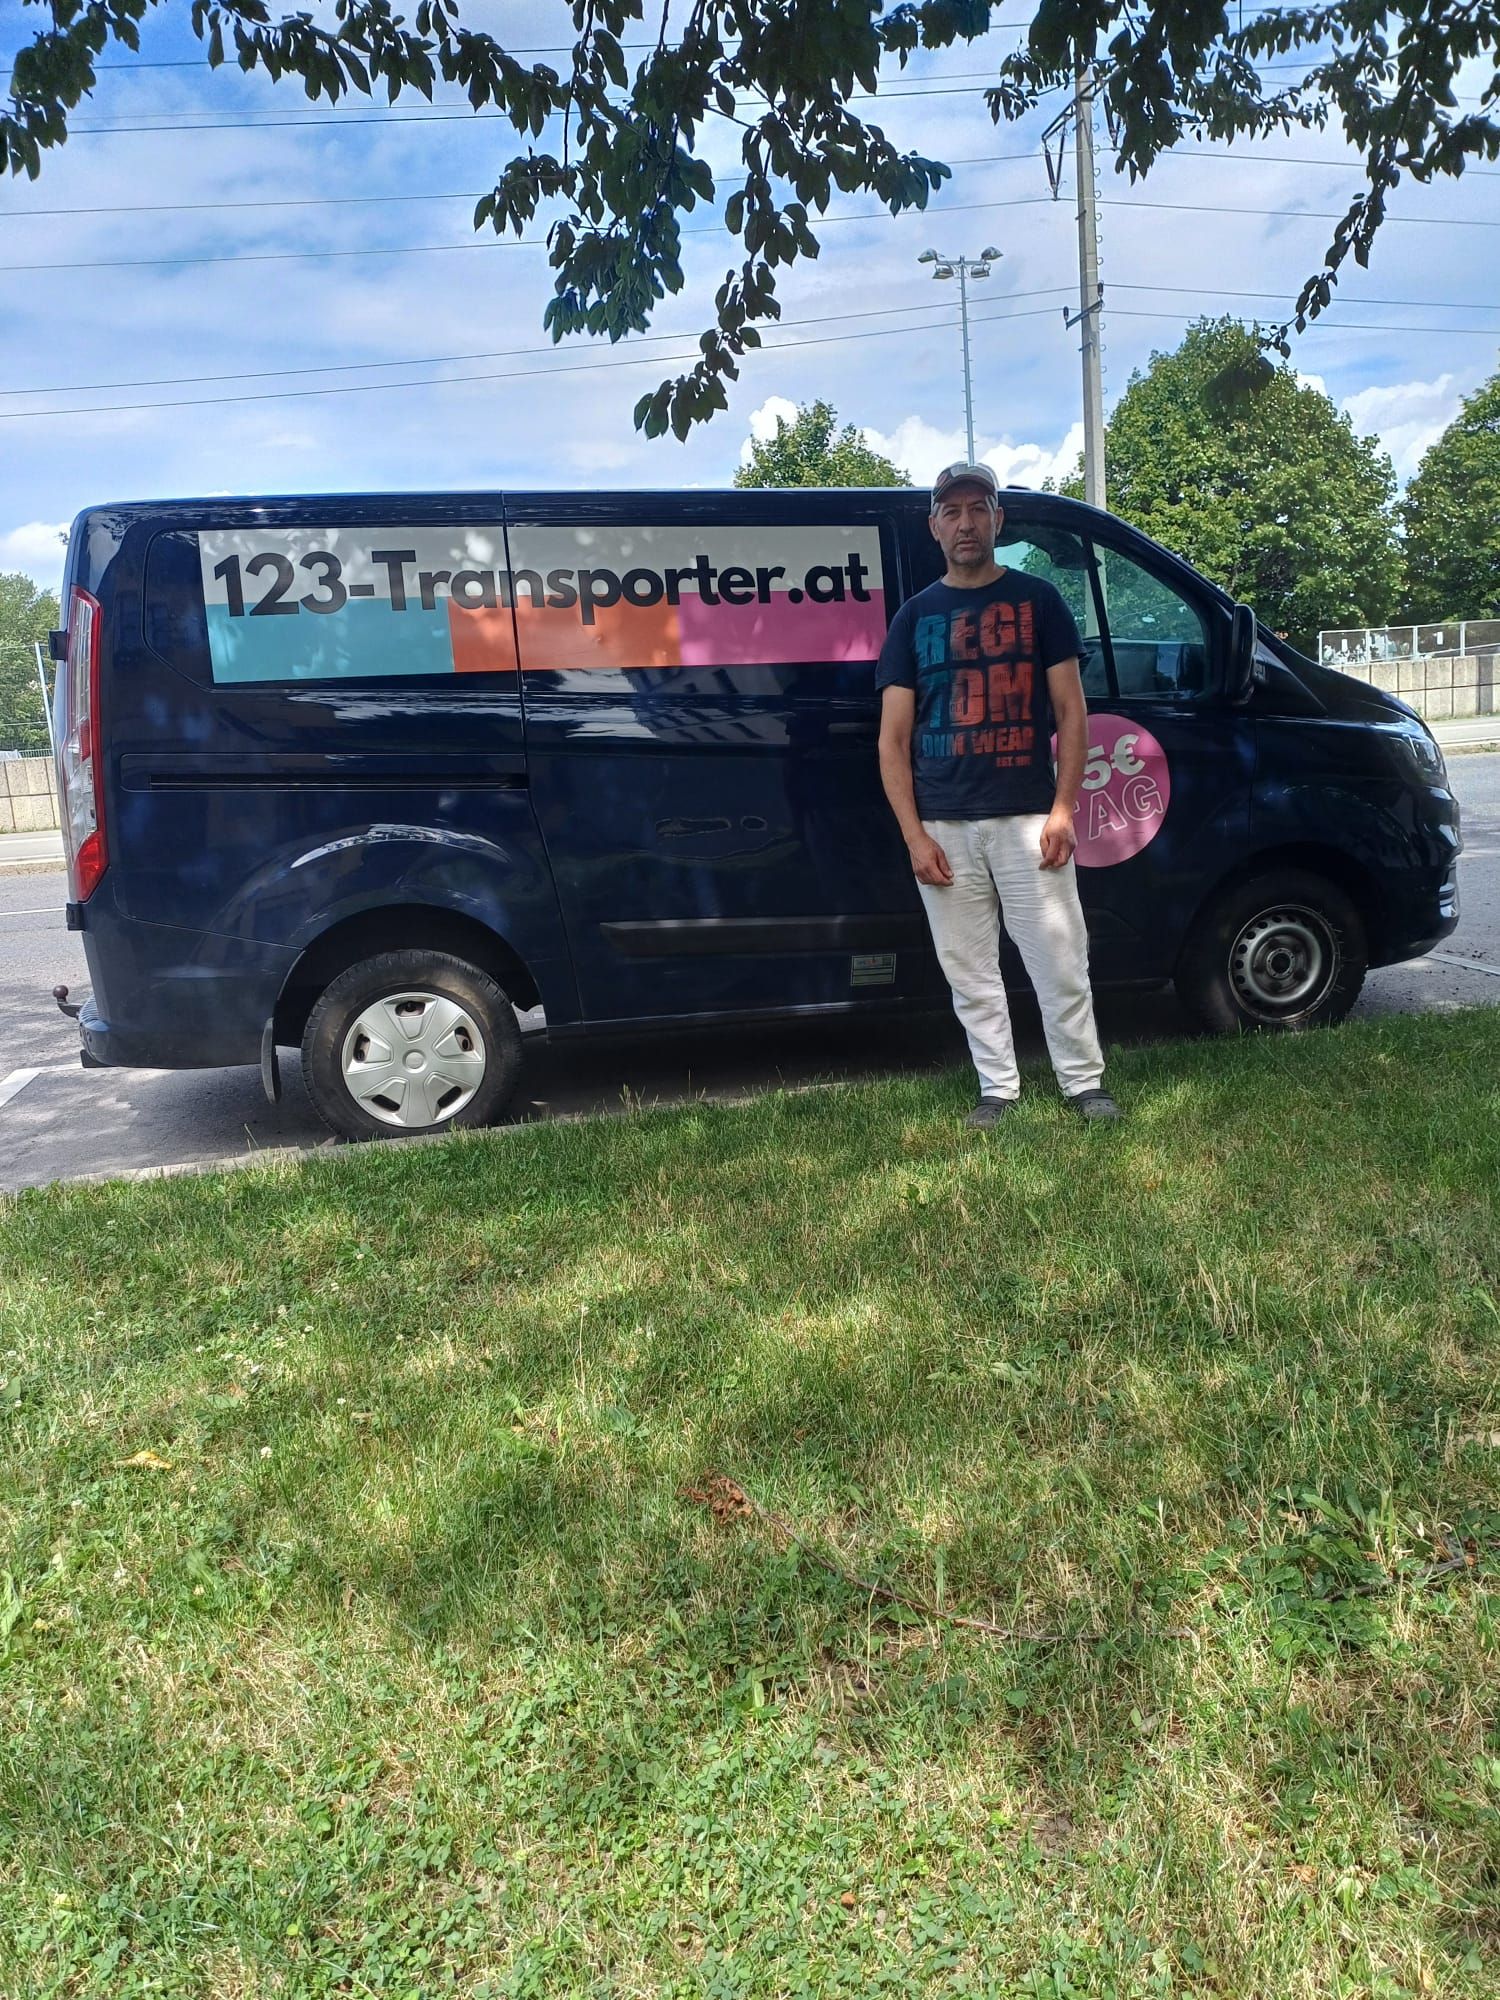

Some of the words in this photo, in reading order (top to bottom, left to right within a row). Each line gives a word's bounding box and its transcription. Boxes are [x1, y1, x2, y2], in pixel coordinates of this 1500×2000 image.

[213, 549, 871, 626] 123-Transporter.at
[1054, 734, 1146, 790] 5€
[1074, 775, 1164, 840] AG
